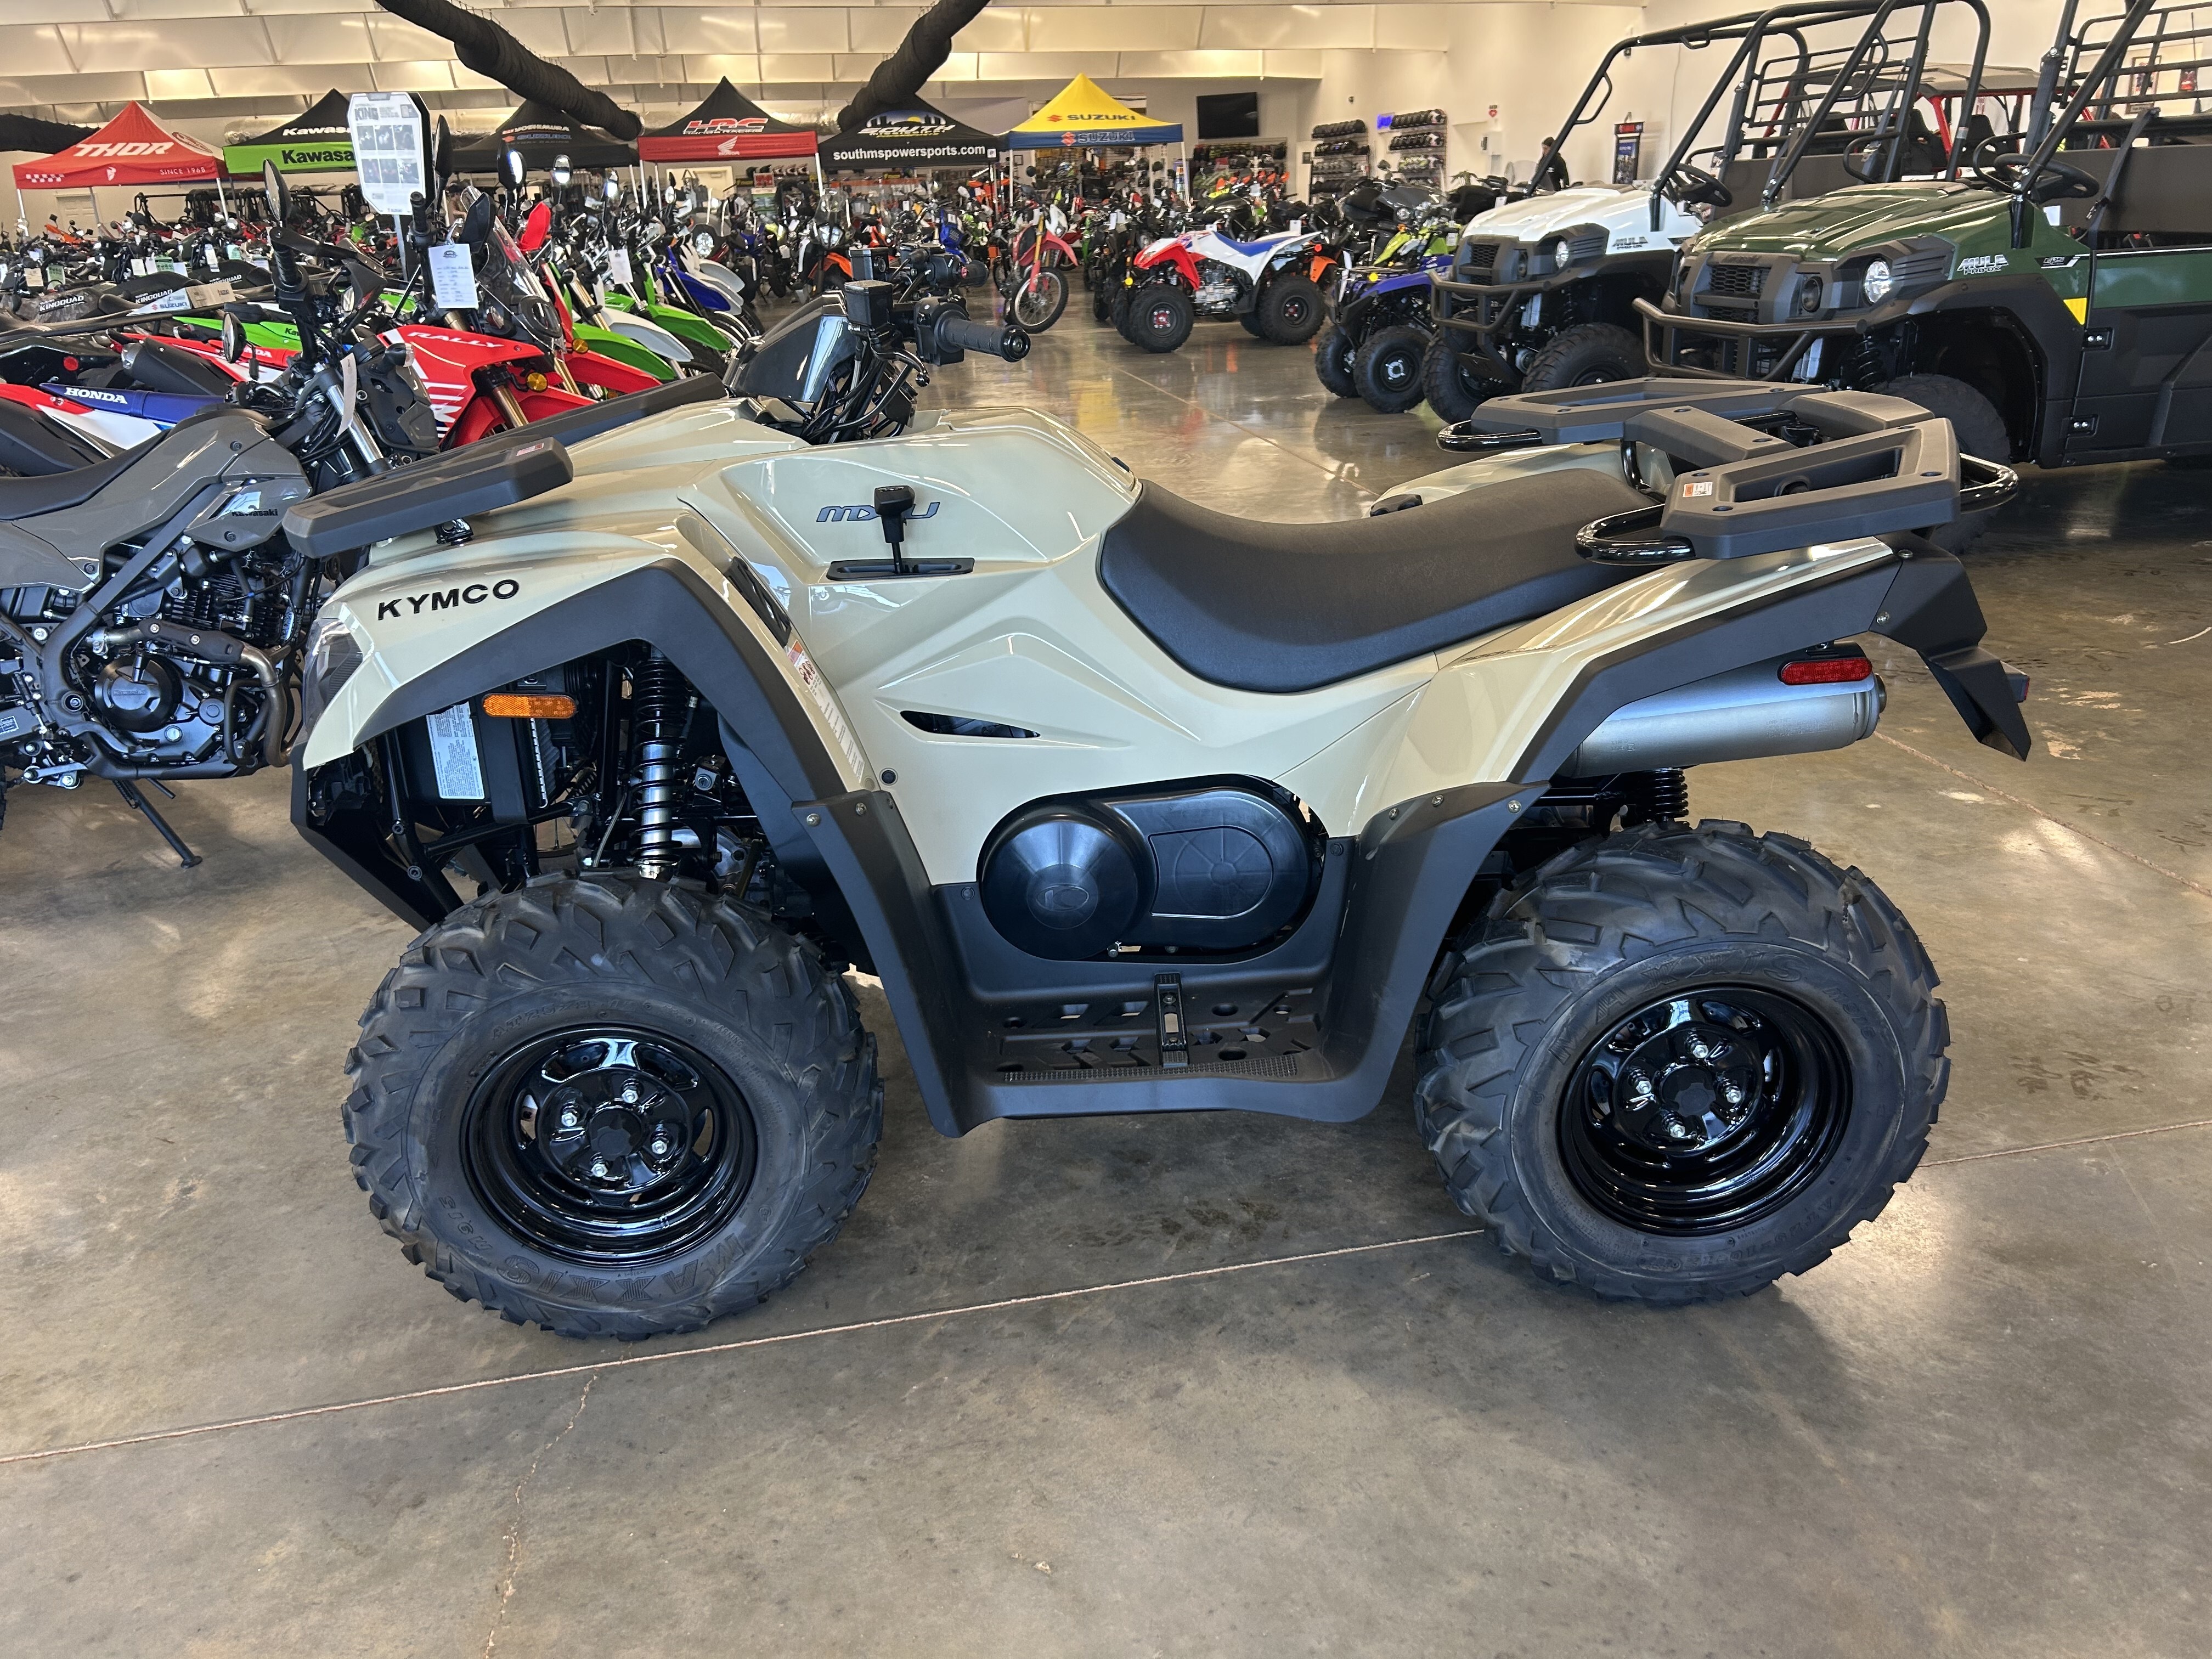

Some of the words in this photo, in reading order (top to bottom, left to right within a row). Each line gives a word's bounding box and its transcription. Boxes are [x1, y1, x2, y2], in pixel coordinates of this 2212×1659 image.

[857, 125, 956, 134] SOUTH
[1077, 131, 1136, 143] SUZUKI
[73, 142, 174, 157] THOR
[281, 149, 356, 164] Kawasa
[833, 145, 986, 161] southmspowersports.com
[1956, 254, 2009, 271] MULE
[40, 295, 84, 312] KINGQUAD
[136, 289, 173, 304] KINGQUAD
[408, 331, 505, 348] RALLY
[64, 387, 128, 404] HONDA
[232, 509, 278, 517] Kawasaki
[378, 579, 520, 621] KYMCO
[1547, 950, 1809, 1064] MAXXIS
[495, 1232, 747, 1304] MAXXIS
